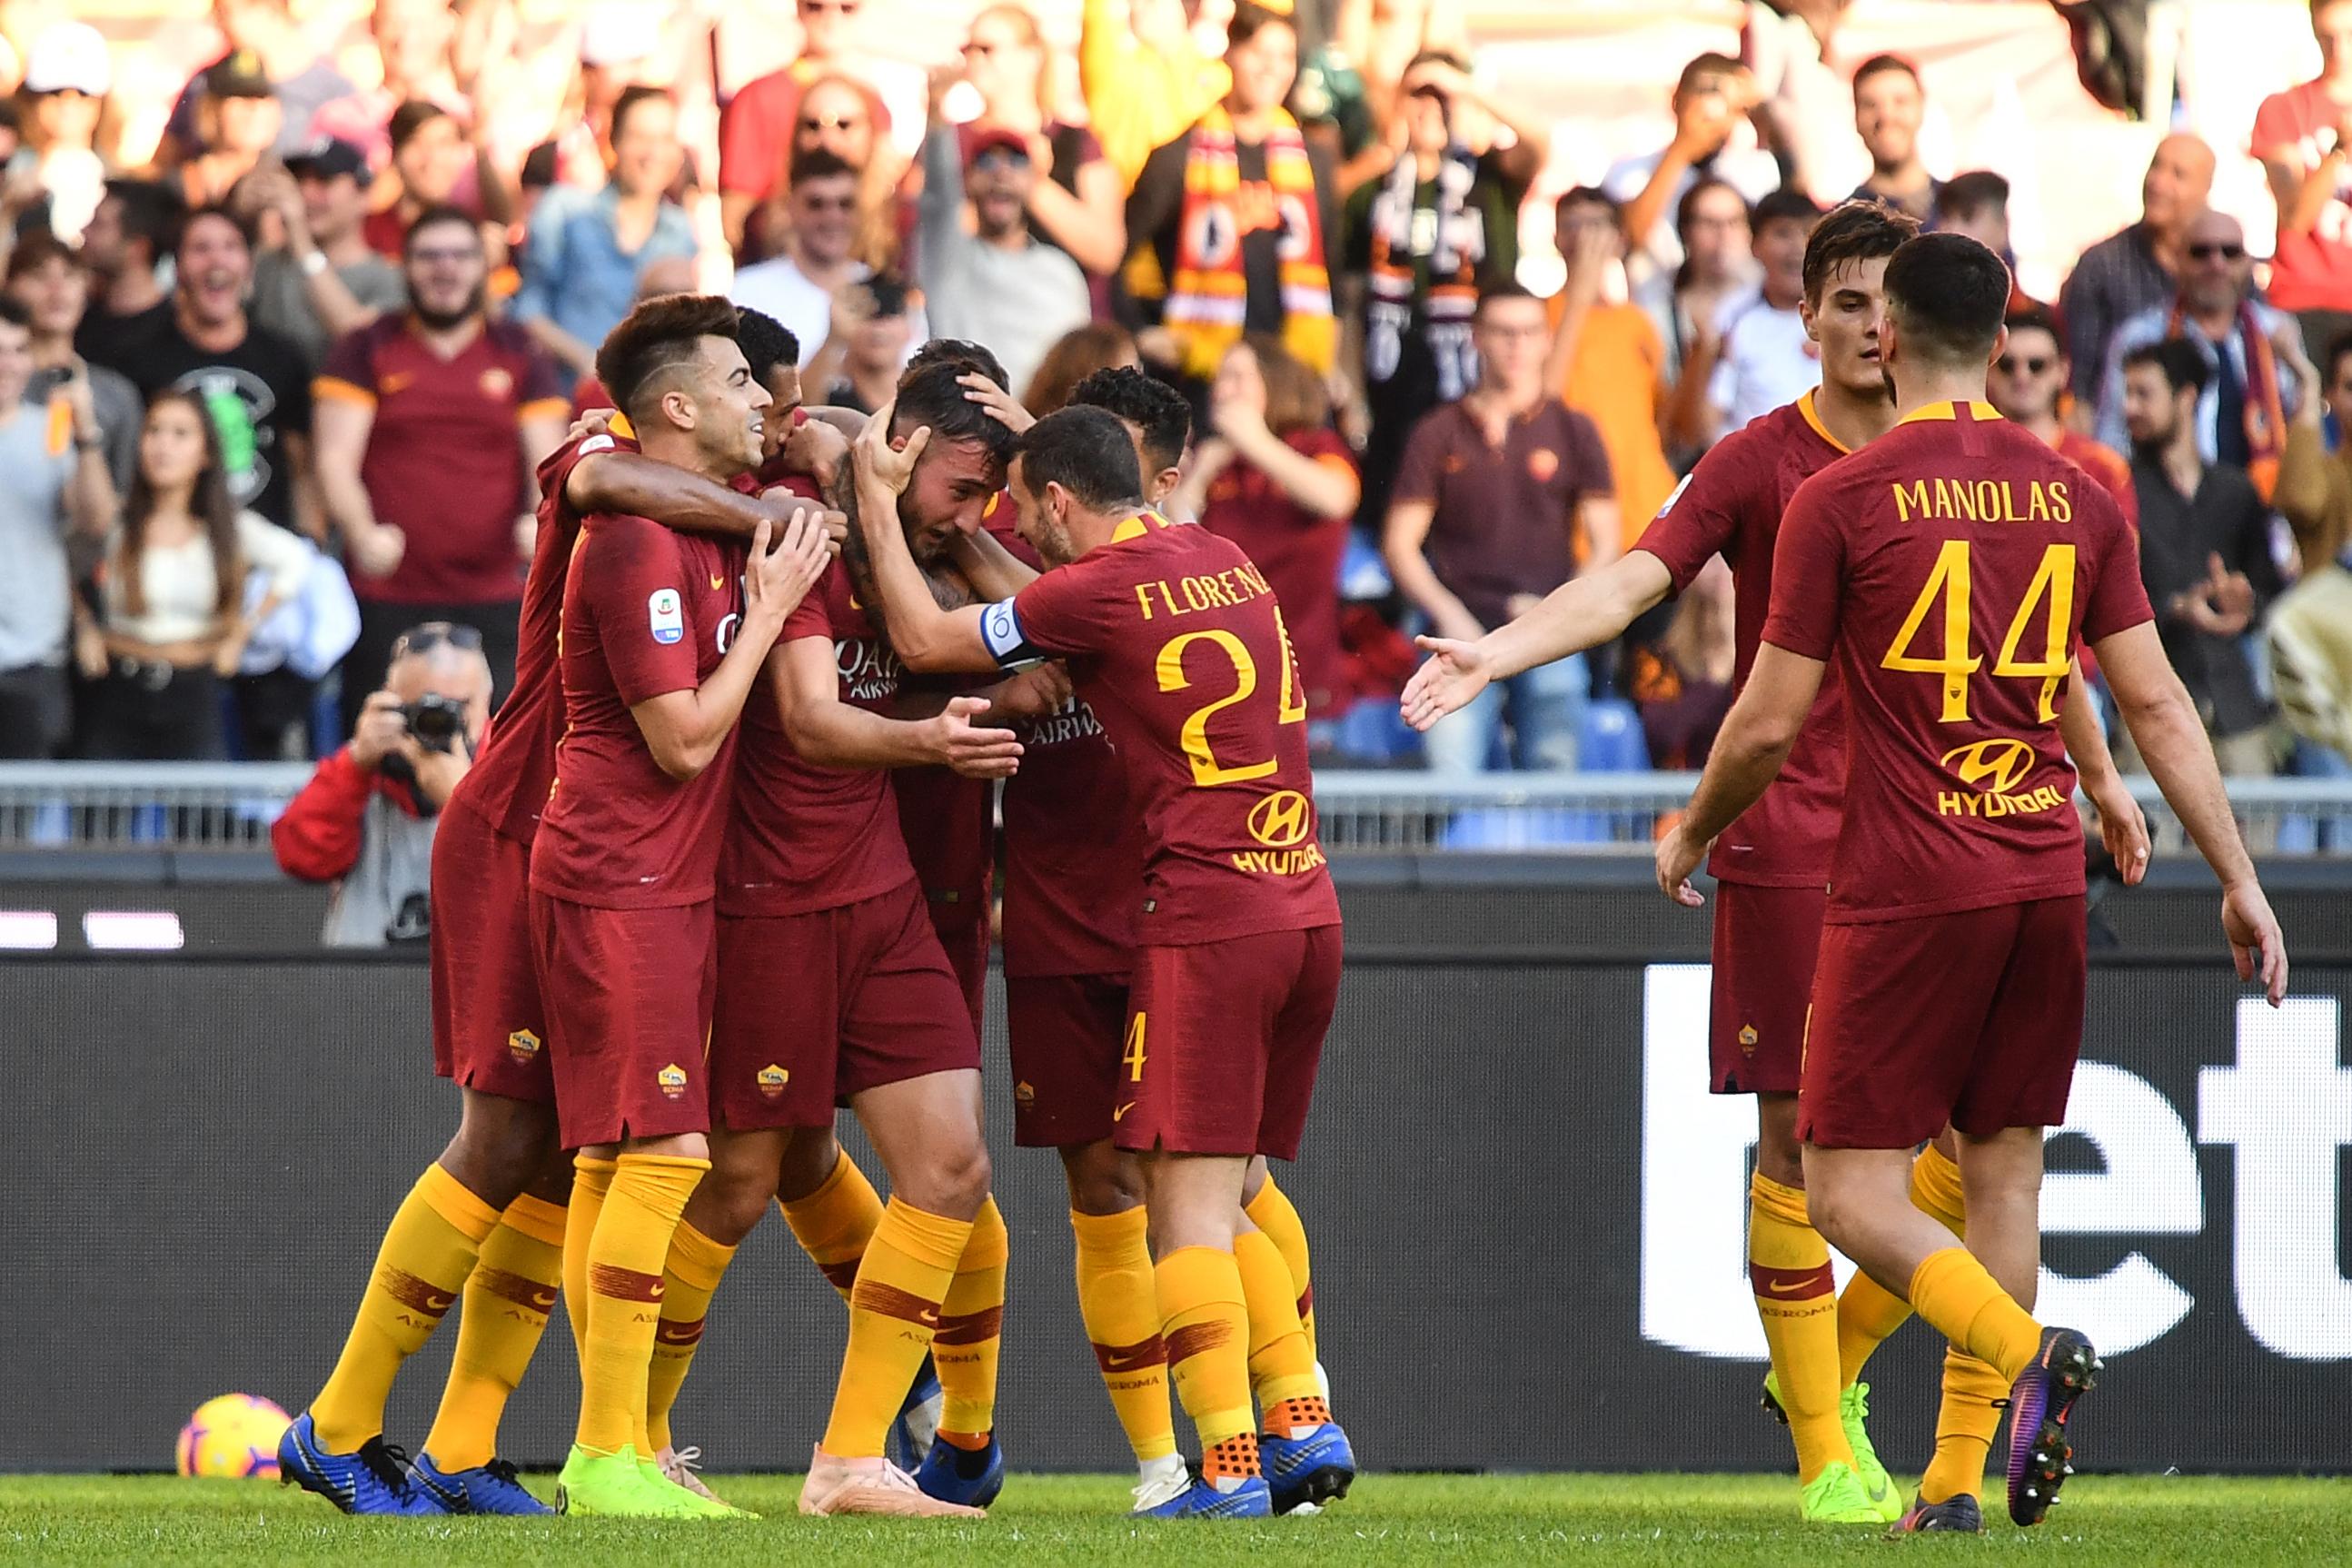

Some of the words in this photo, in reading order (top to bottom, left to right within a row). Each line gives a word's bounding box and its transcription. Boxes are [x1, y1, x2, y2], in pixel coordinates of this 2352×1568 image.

[1892, 478, 2072, 523] MANOLAS
[1135, 561, 1272, 620] FLOREN
[1880, 540, 2076, 724] 44
[1028, 713, 1104, 745] AIRW
[1938, 784, 2067, 818] HYUNDAI
[1231, 842, 1327, 876] HYUNDA
[1123, 1011, 1148, 1082] 4
[1639, 964, 2352, 1361] bet
